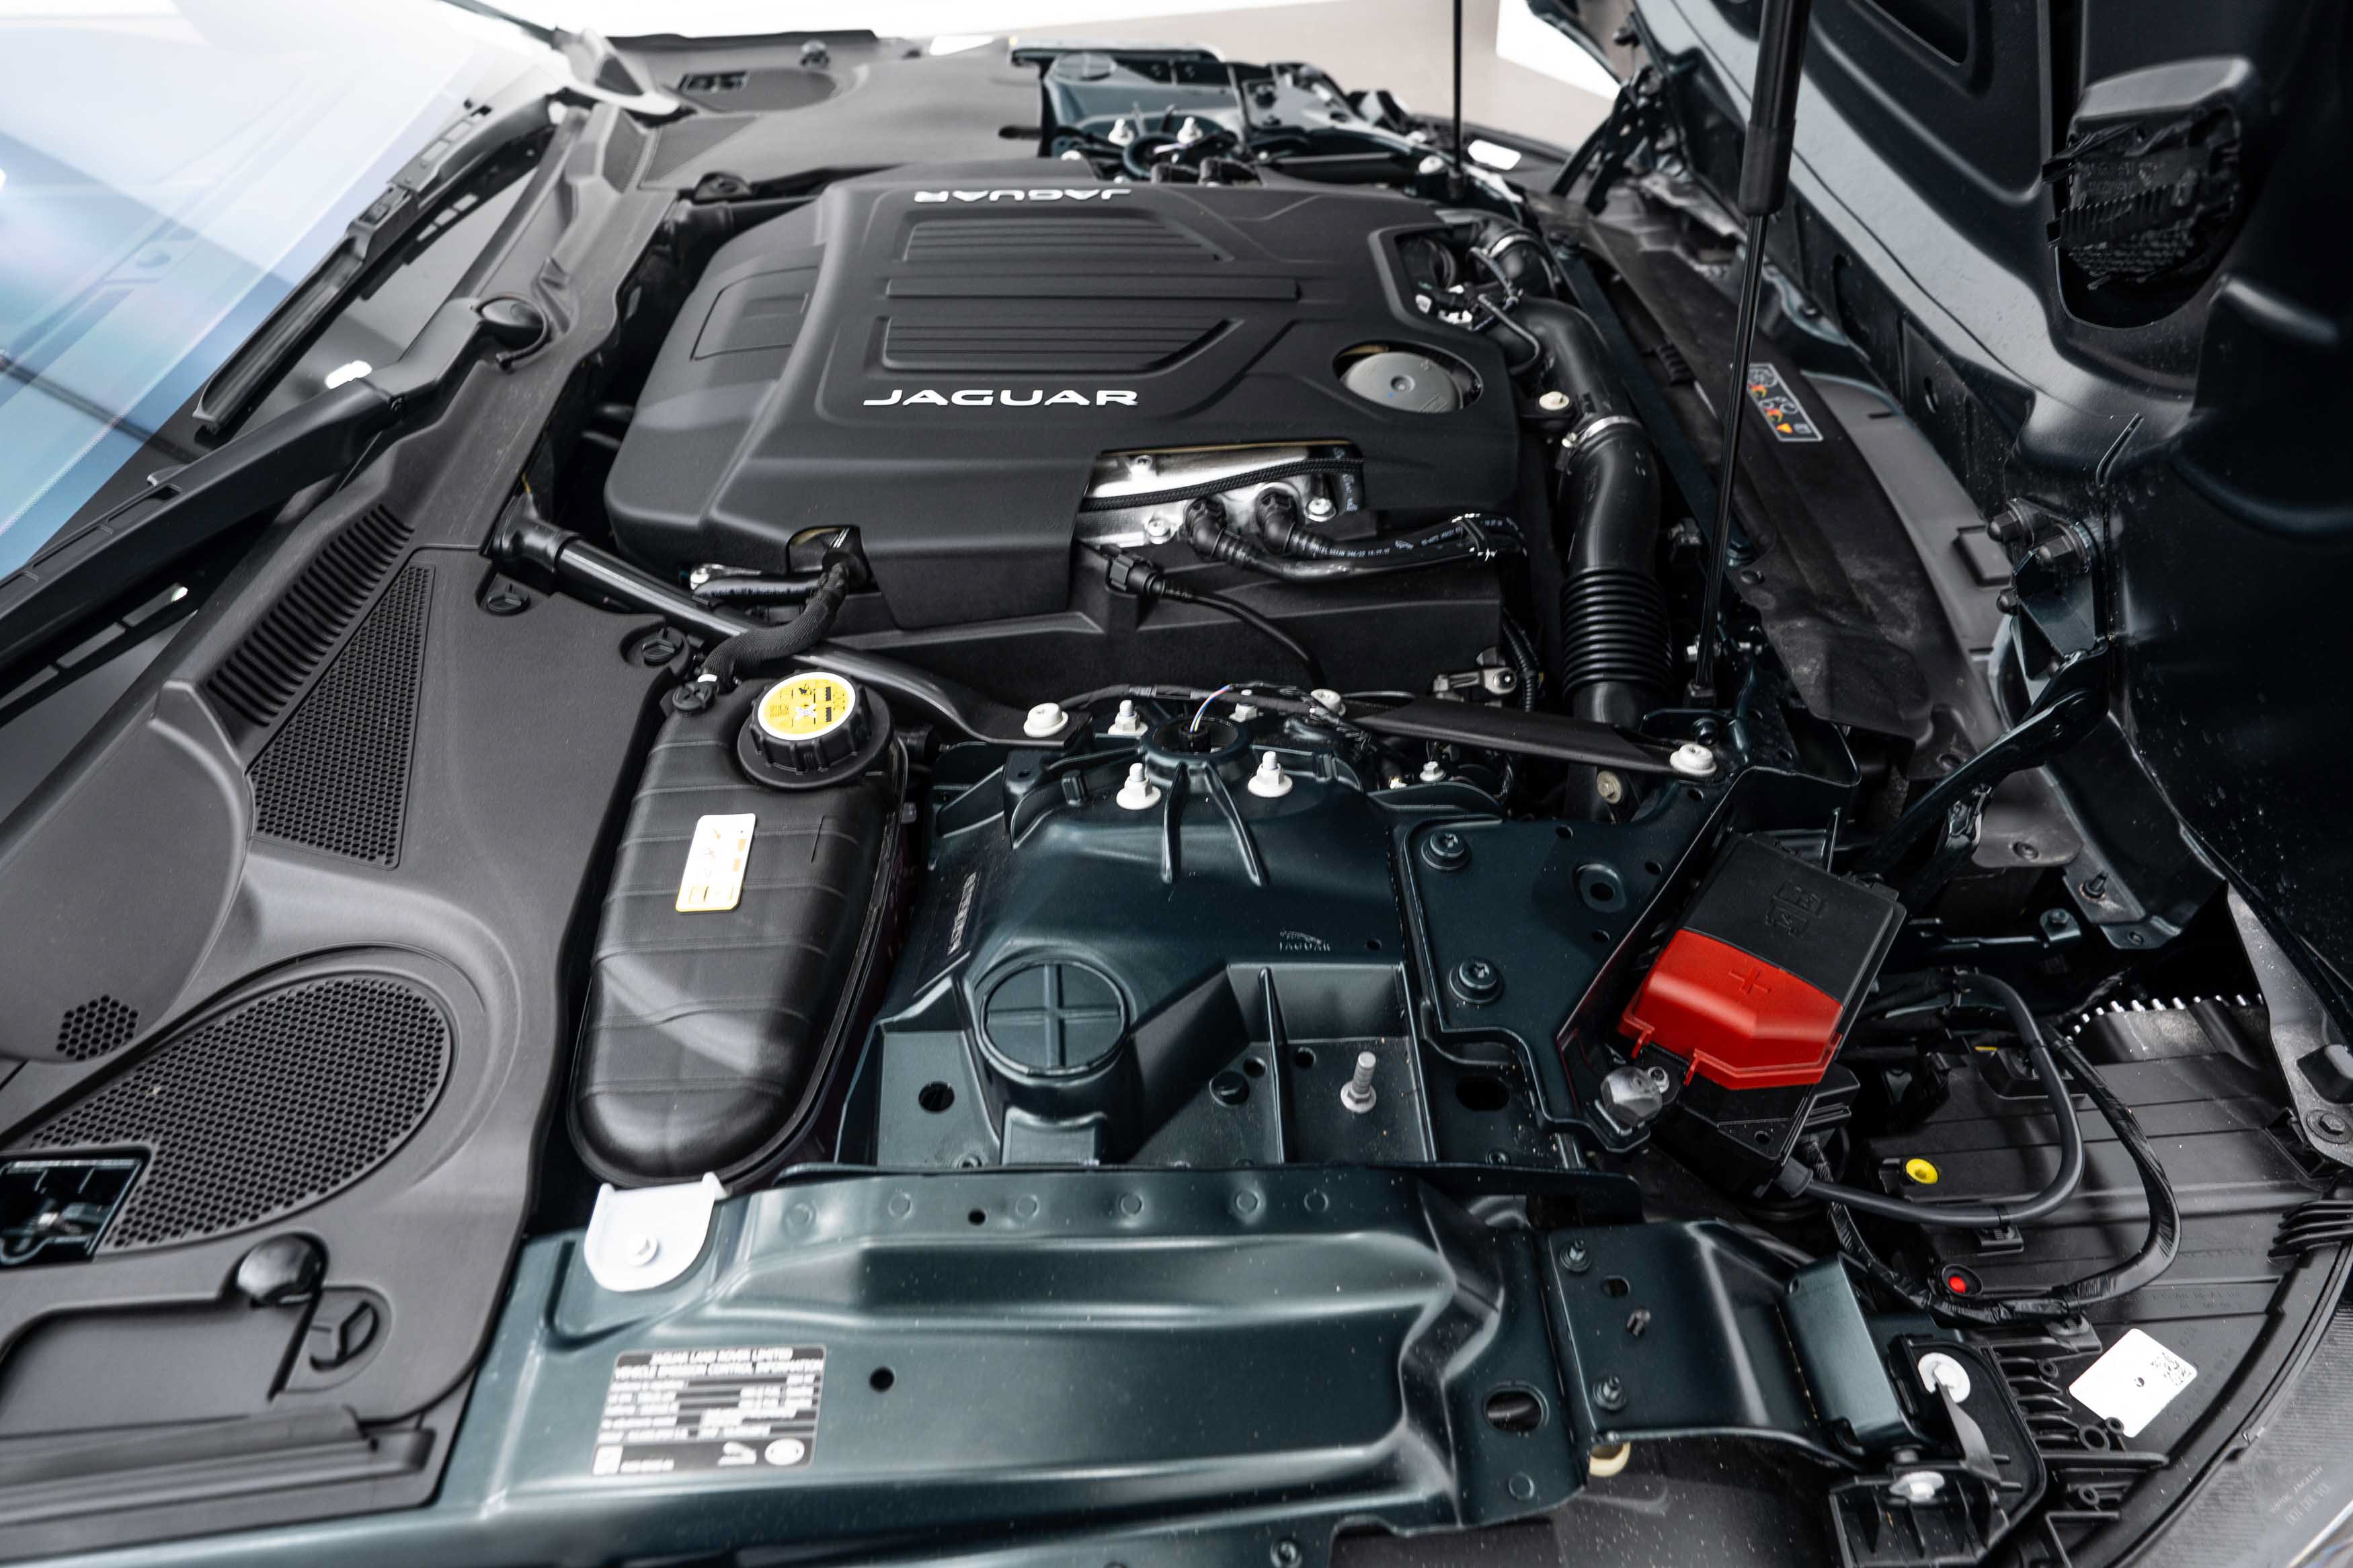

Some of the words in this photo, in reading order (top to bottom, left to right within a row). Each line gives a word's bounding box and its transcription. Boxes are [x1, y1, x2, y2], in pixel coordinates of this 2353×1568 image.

[914, 190, 1131, 203] JAGUAR
[863, 390, 1138, 406] JAGUAR
[1279, 942, 1331, 952] JAGUAR
